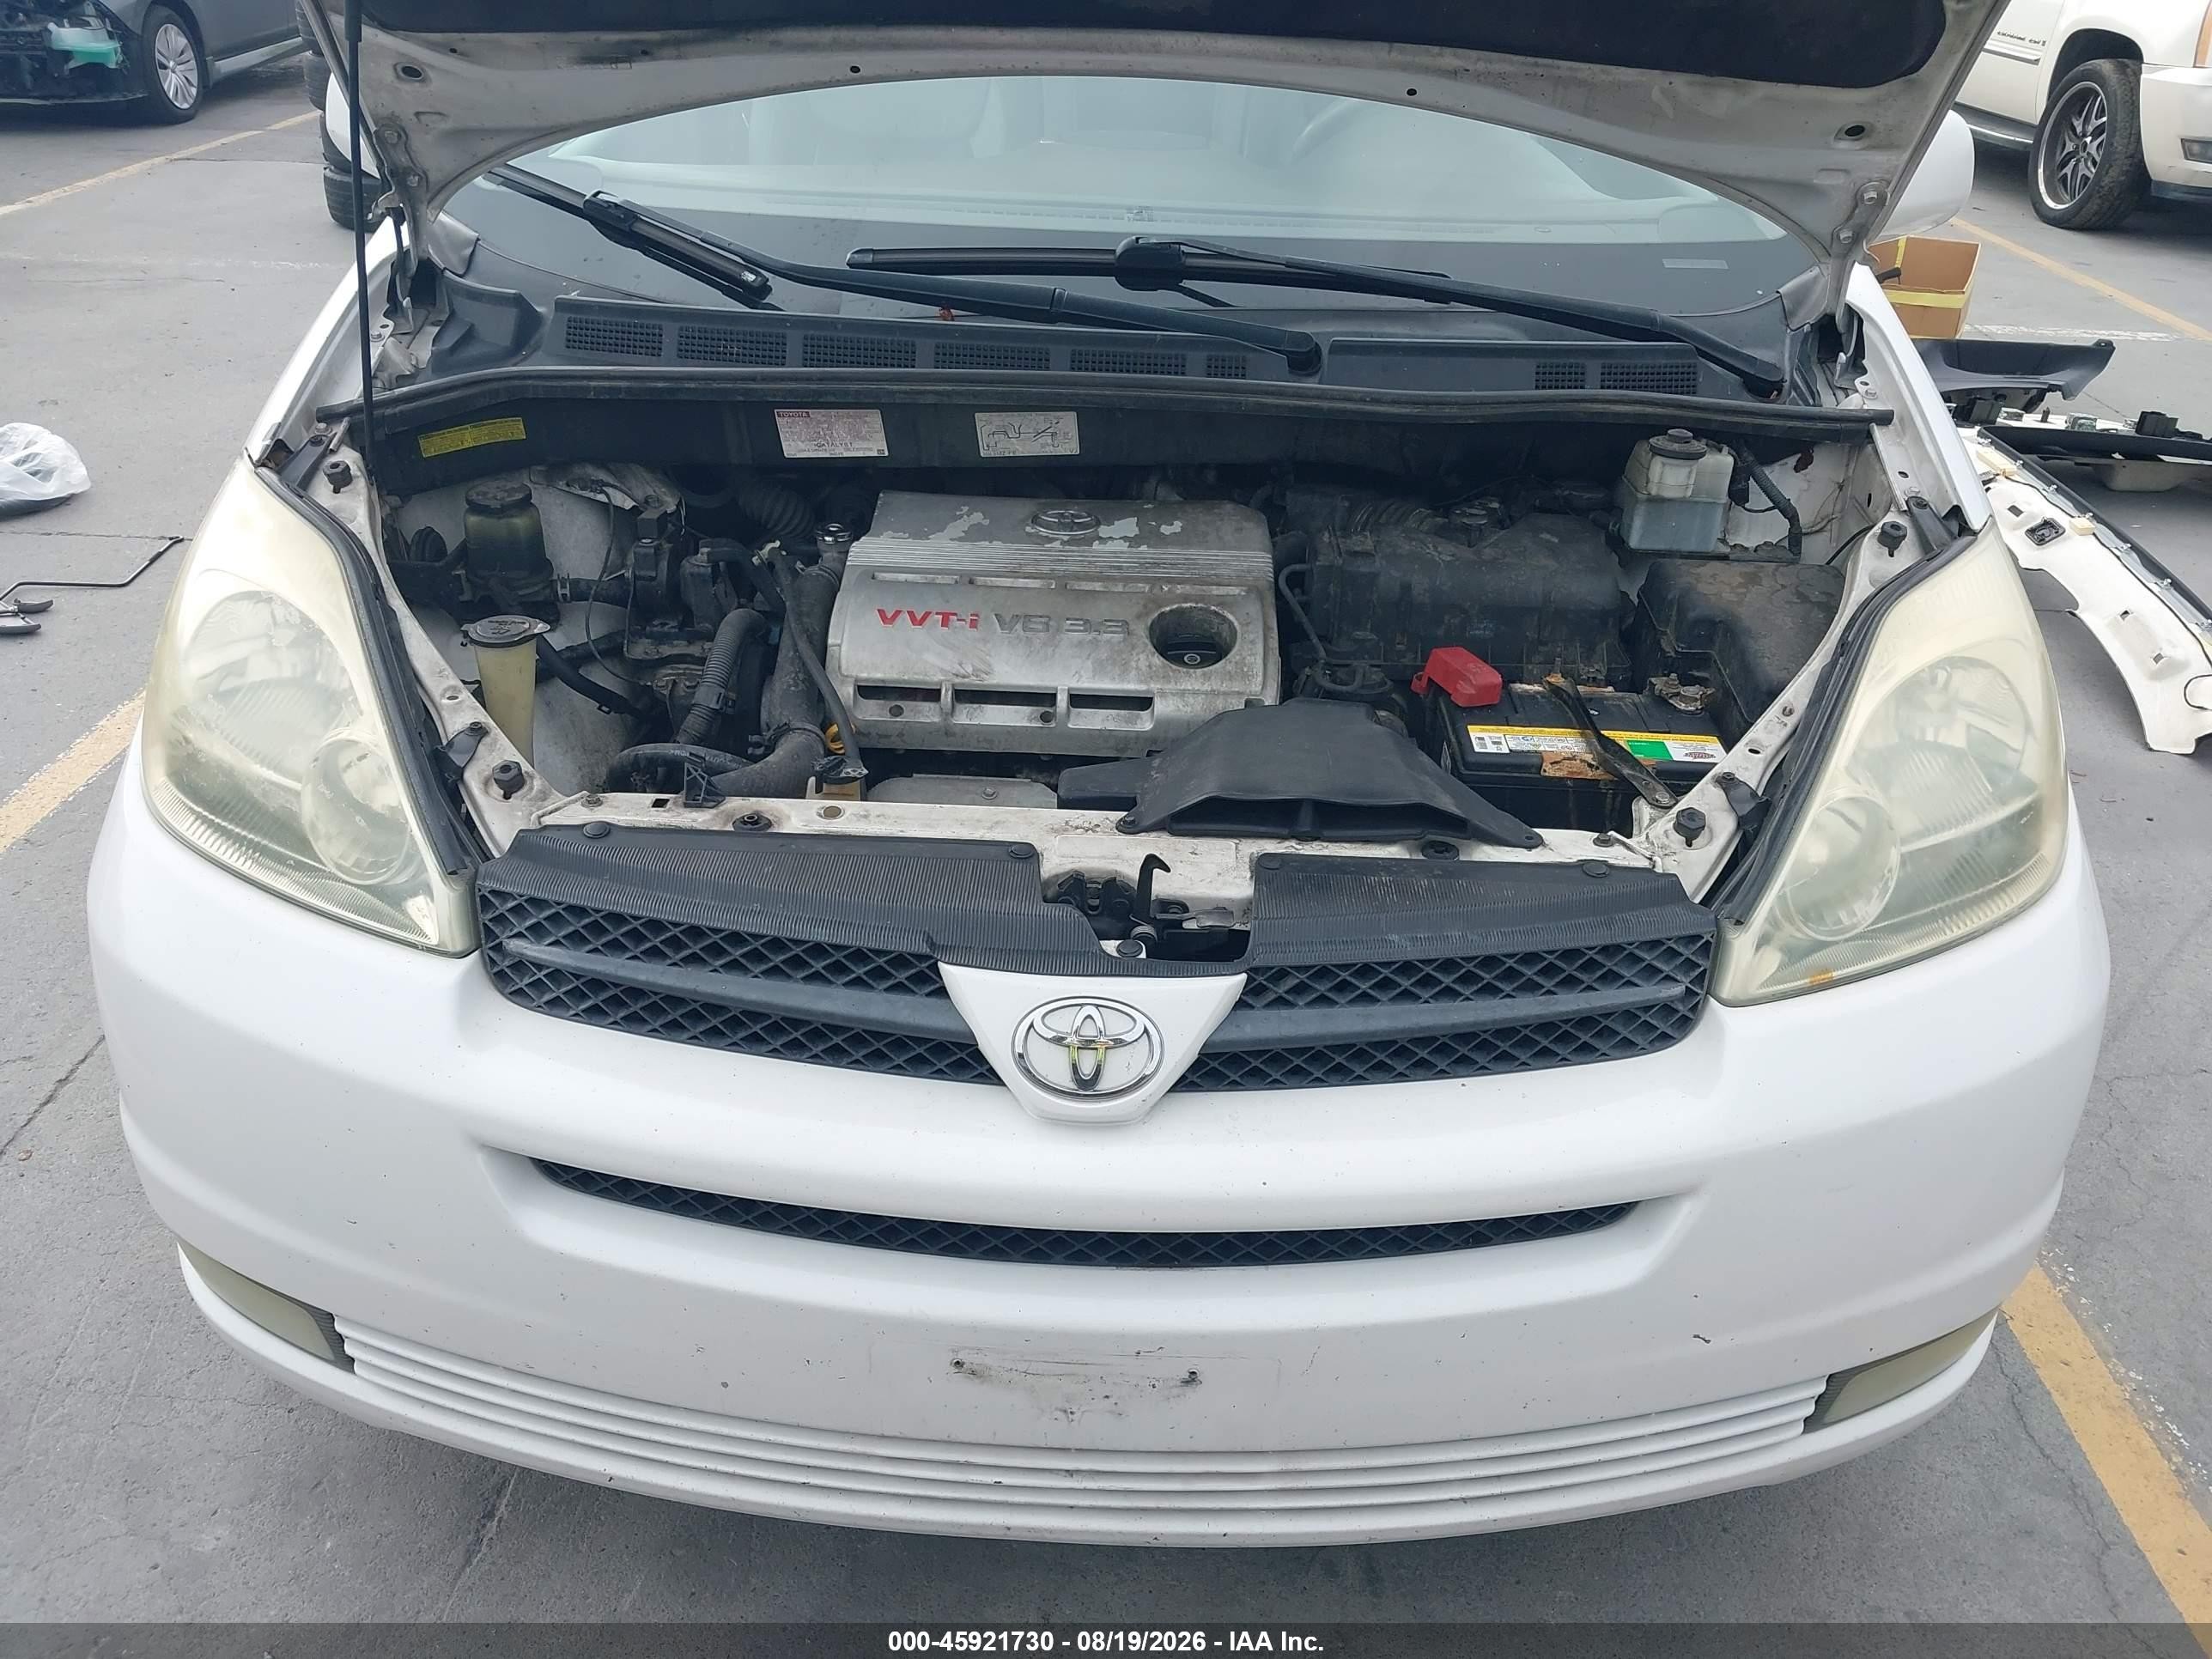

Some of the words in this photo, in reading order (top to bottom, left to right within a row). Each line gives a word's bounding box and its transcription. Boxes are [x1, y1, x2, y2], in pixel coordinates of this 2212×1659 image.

[877, 608, 980, 633] VVT-i
[994, 613, 1052, 635] V6
[1064, 617, 1130, 637] 3.3
